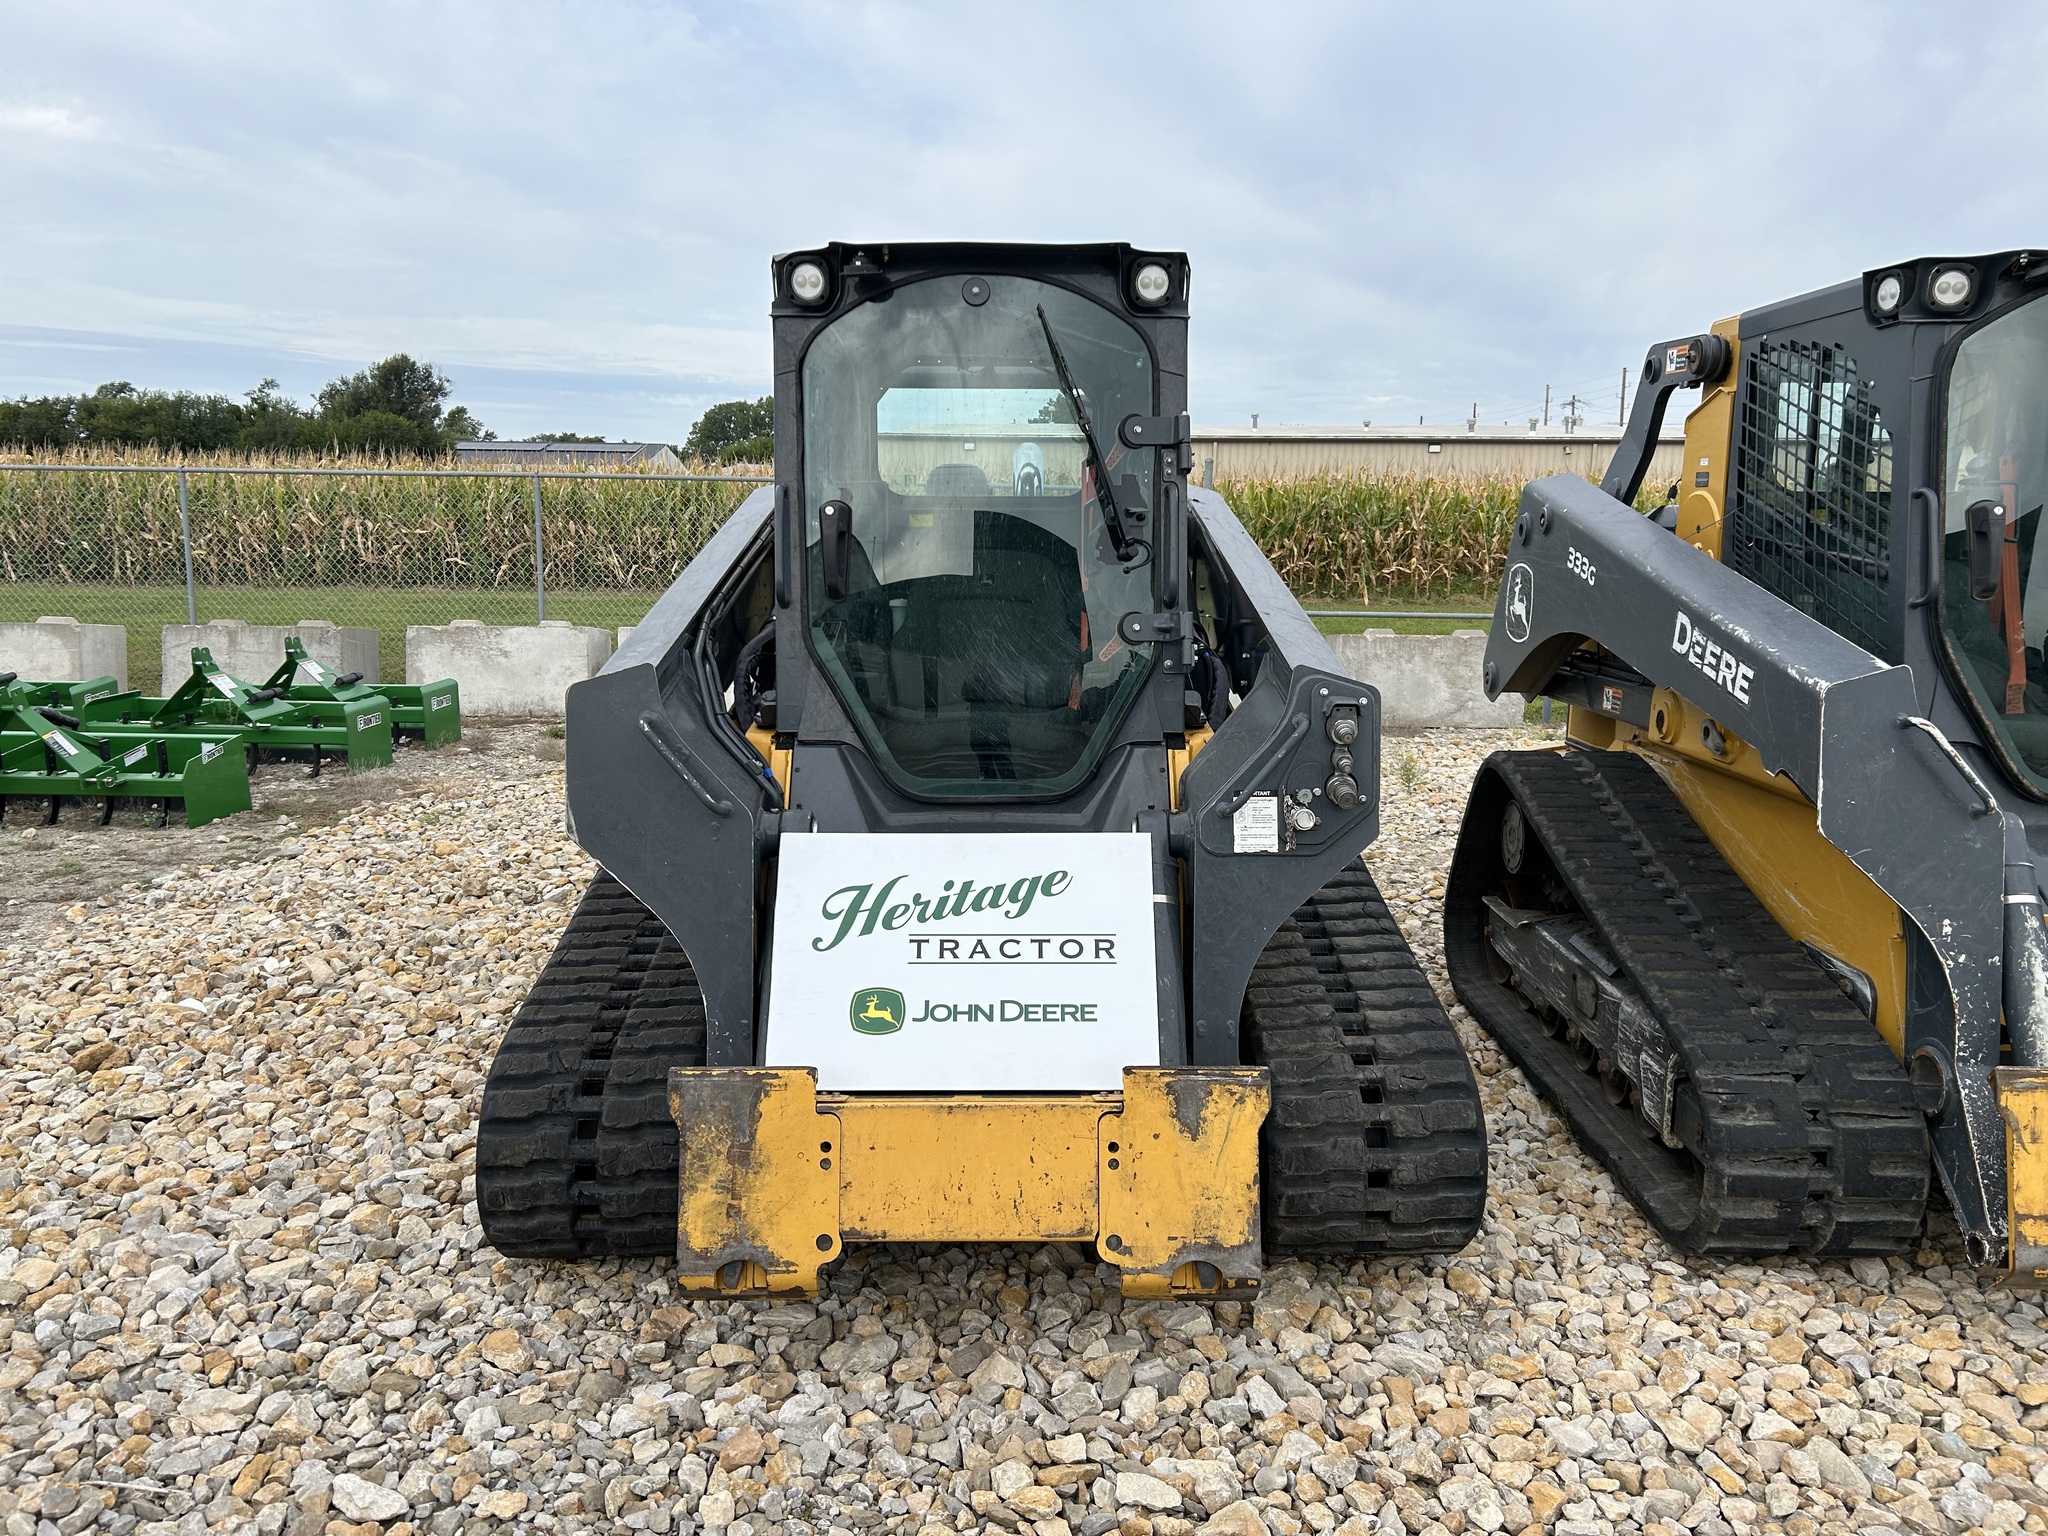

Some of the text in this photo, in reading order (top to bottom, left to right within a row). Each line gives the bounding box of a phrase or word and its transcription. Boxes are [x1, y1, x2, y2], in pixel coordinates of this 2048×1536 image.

[1567, 546, 1597, 586] 333G
[1672, 611, 1755, 705] DEERE
[357, 713, 380, 730] FRONTIER
[812, 870, 1073, 952] Heritage
[909, 939, 1117, 960] TRACTOR
[912, 1000, 1098, 1022] JOHN DEERE
